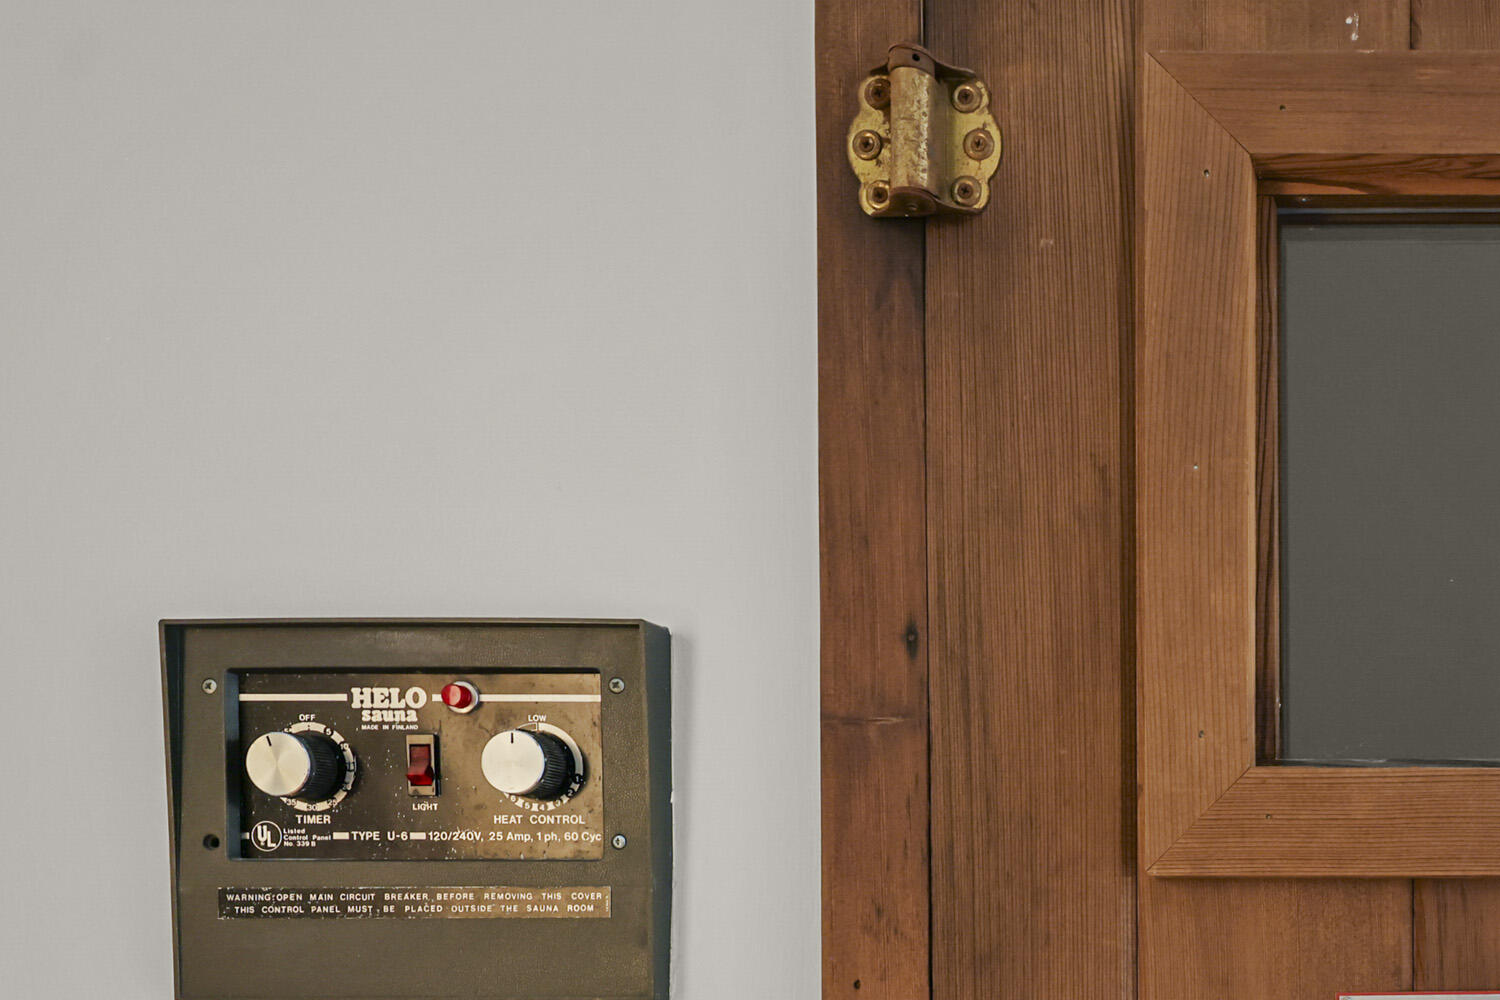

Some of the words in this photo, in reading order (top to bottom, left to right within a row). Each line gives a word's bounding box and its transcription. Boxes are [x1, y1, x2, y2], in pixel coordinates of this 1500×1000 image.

[350, 686, 428, 709] HELO
[298, 713, 316, 721] OFF
[361, 709, 418, 722] sauna
[527, 714, 547, 722] LOW
[412, 803, 438, 811] LIGHT
[295, 814, 331, 825] TIMER
[493, 814, 523, 825] HEAT
[529, 814, 586, 825] CONTROL
[351, 831, 380, 841] TYPE
[387, 831, 409, 841] U-6
[428, 831, 484, 842] 120/240V,
[488, 831, 504, 841] 25
[506, 831, 534, 843] Amp,
[563, 831, 579, 841] 60
[580, 831, 602, 843] Cyc
[309, 893, 334, 901] MAIN
[339, 893, 376, 901] CIRCUIT
[384, 892, 429, 901] BREAKER
[436, 892, 475, 901] BEFORE
[483, 892, 533, 900] REMOVING
[541, 892, 563, 900] THIS
[570, 892, 603, 900] COVER
[234, 905, 255, 913] THIS
[261, 905, 305, 913] CONTROL
[311, 905, 341, 913] PANEL
[347, 905, 373, 913] MUST
[383, 905, 395, 913] BE
[404, 904, 443, 912] PLACED
[450, 904, 493, 912] OUTSIDE
[500, 904, 519, 912] THE
[526, 904, 559, 912] SAUNA
[566, 904, 594, 912] ROOM
